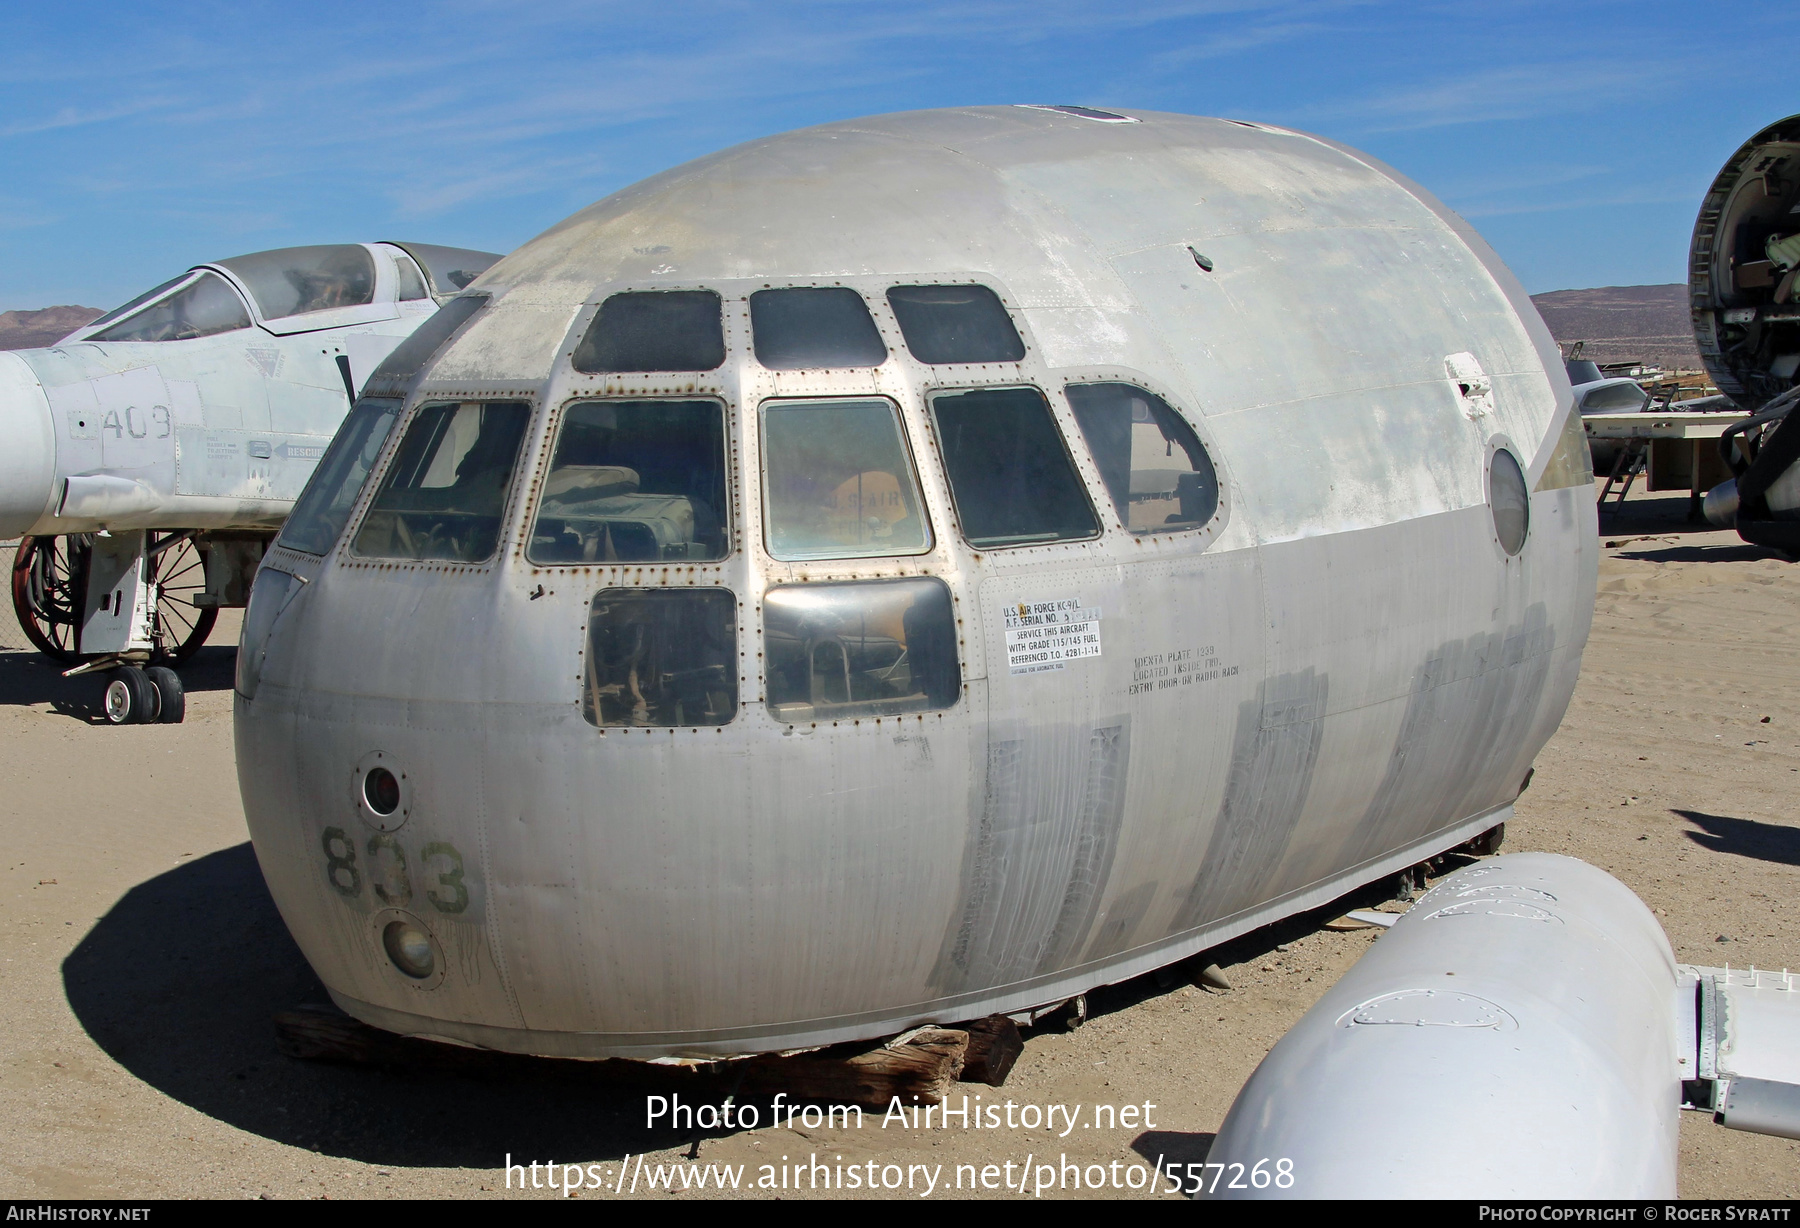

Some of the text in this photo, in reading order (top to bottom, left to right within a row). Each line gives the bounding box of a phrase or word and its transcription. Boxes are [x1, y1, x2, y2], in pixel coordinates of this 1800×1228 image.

[287, 446, 323, 457] RESCUE
[1003, 606, 1018, 617] U.S.
[1020, 605, 1032, 616] AIR
[1034, 602, 1055, 614] FORCE
[1021, 615, 1043, 627] SERIAL
[1046, 613, 1058, 624] NO.
[1017, 623, 1089, 640] SERVICE THIS AIRCRAFT
[1009, 643, 1026, 653] WITH
[1029, 640, 1050, 651] GRADE
[1053, 636, 1081, 647] 115/145
[1011, 652, 1048, 665] REFERENCED
[1050, 650, 1062, 660] T.O.
[1168, 649, 1191, 662] PLATE
[1133, 667, 1168, 681] LOCATED
[1174, 661, 1201, 675] INSIDE
[1129, 682, 1154, 695] ENTRY
[1195, 670, 1218, 683] RADIO
